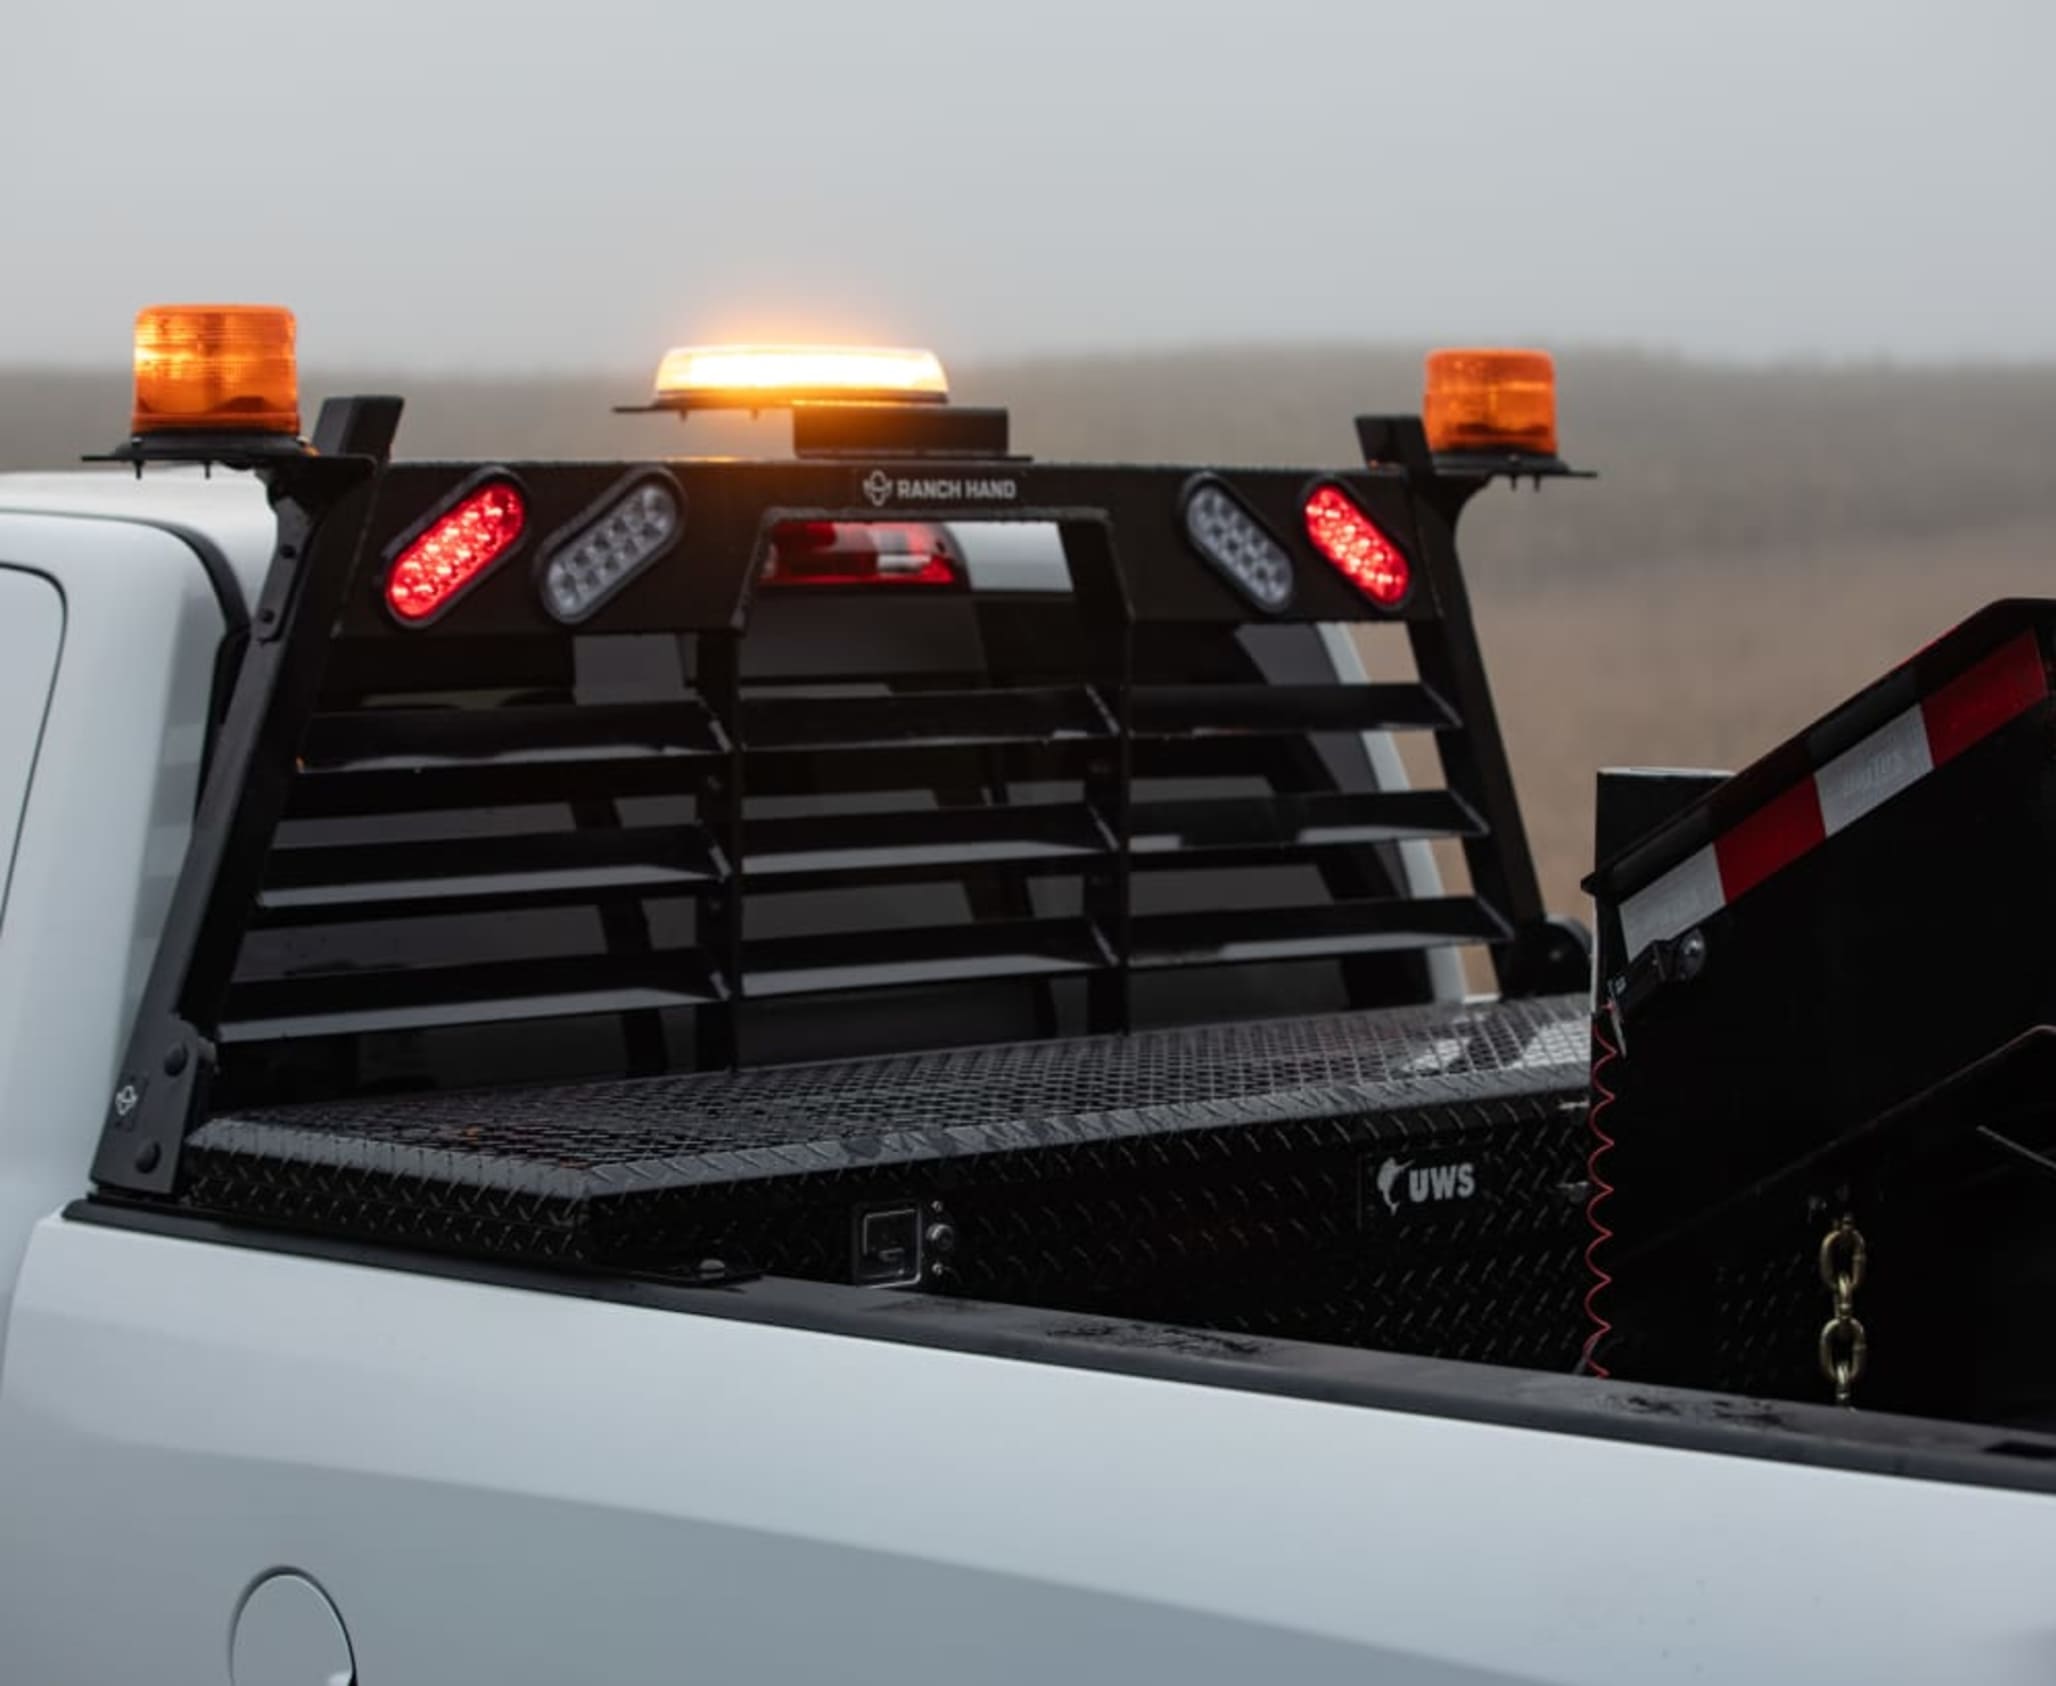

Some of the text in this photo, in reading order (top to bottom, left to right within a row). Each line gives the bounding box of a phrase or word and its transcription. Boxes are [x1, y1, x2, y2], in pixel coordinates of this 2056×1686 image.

[897, 480, 1016, 498] RANCH HAND
[1409, 1163, 1475, 1202] UWS
